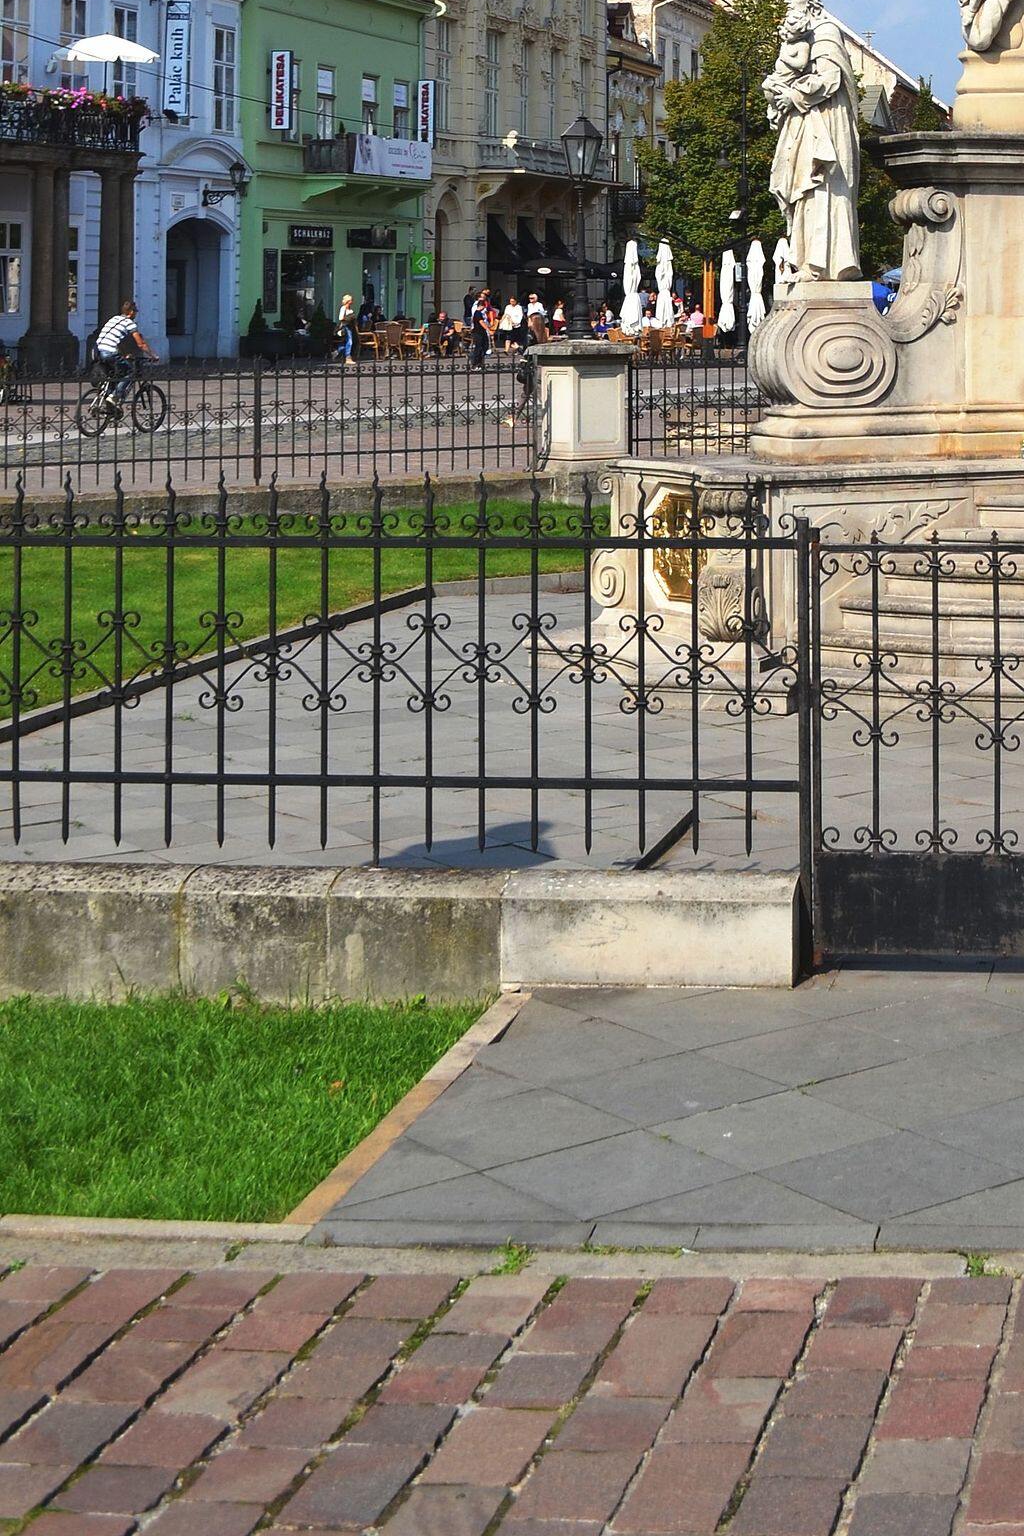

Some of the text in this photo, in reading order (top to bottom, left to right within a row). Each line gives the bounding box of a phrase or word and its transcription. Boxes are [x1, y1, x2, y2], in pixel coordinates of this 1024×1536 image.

[170, 28, 184, 60] knih
[168, 66, 182, 104] Palác
[275, 54, 285, 125] DELIKATESA
